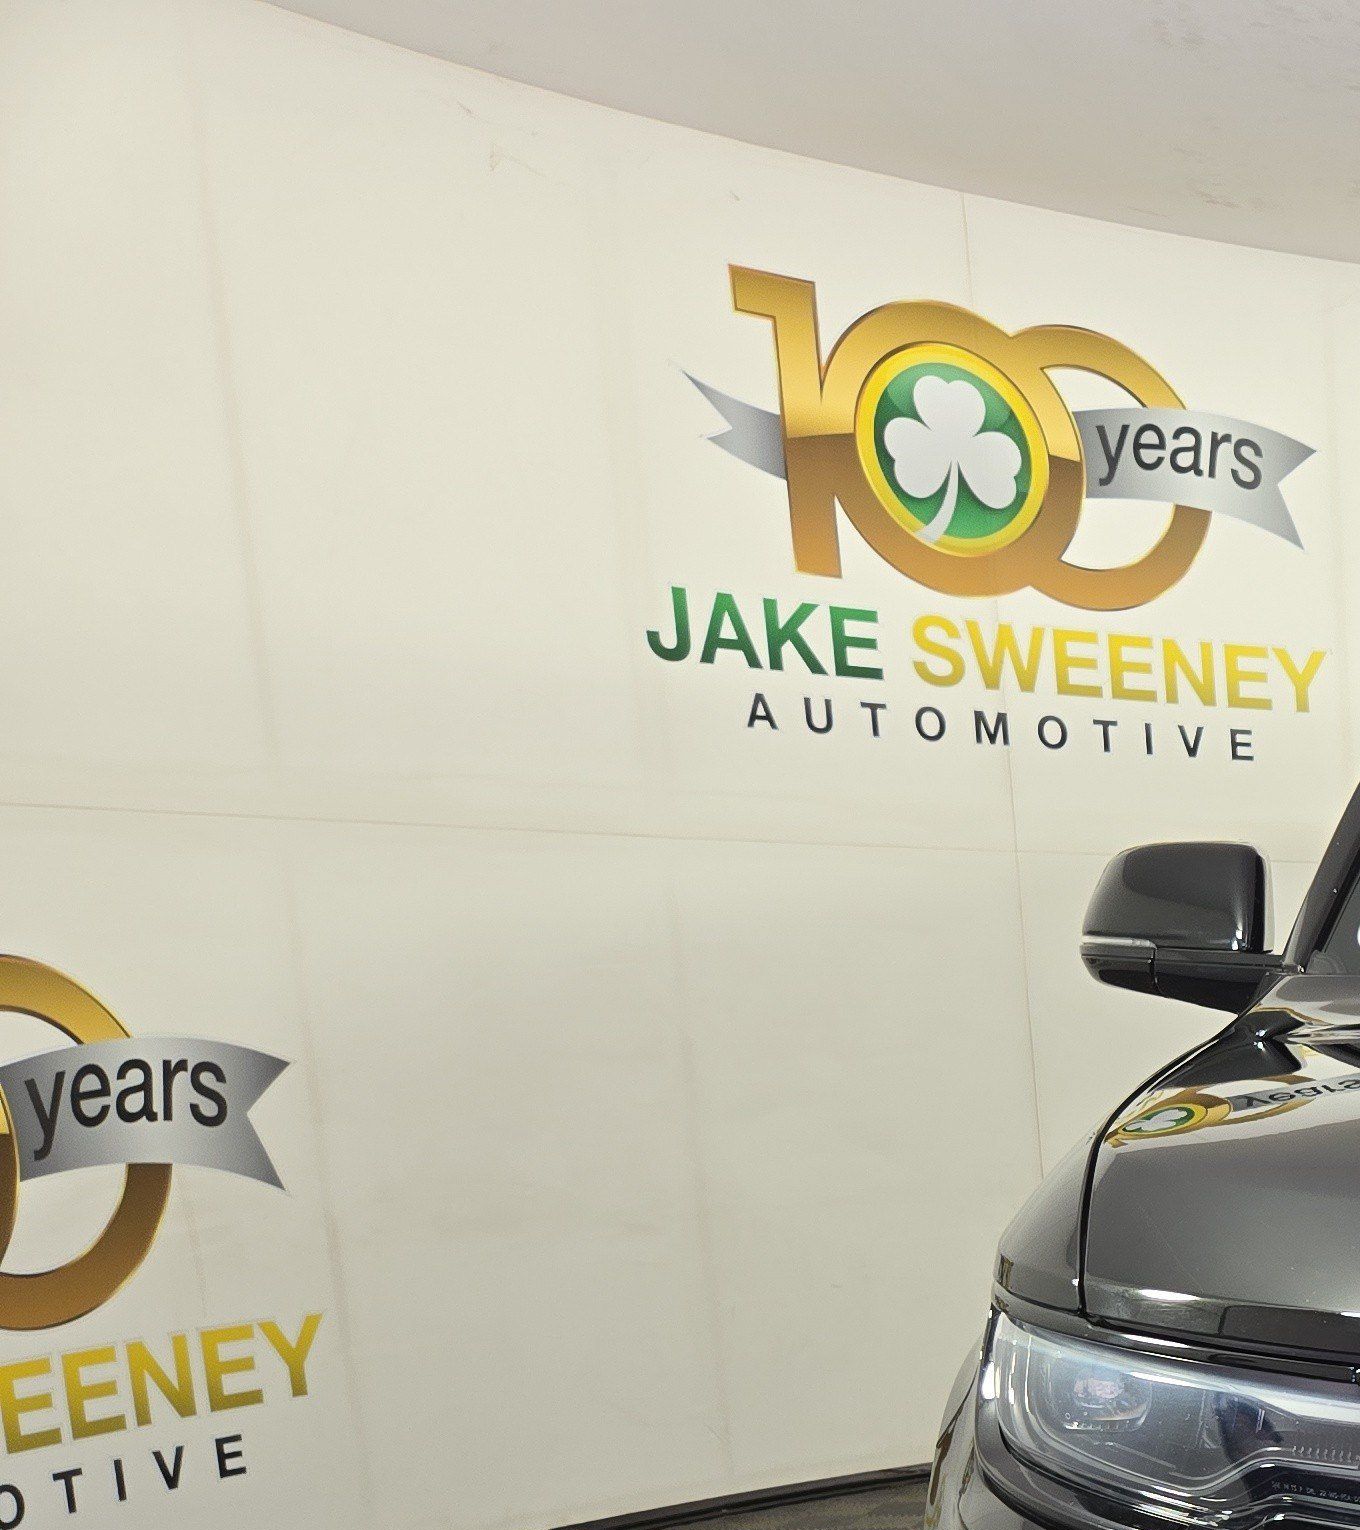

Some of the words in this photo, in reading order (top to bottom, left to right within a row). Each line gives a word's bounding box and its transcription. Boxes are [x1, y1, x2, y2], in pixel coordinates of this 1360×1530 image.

[1095, 420, 1264, 492] years
[646, 586, 884, 680] JAKE
[910, 614, 1327, 713] SWEENEY
[747, 693, 1255, 761] AUTOMOTIVE
[24, 1057, 229, 1161] years
